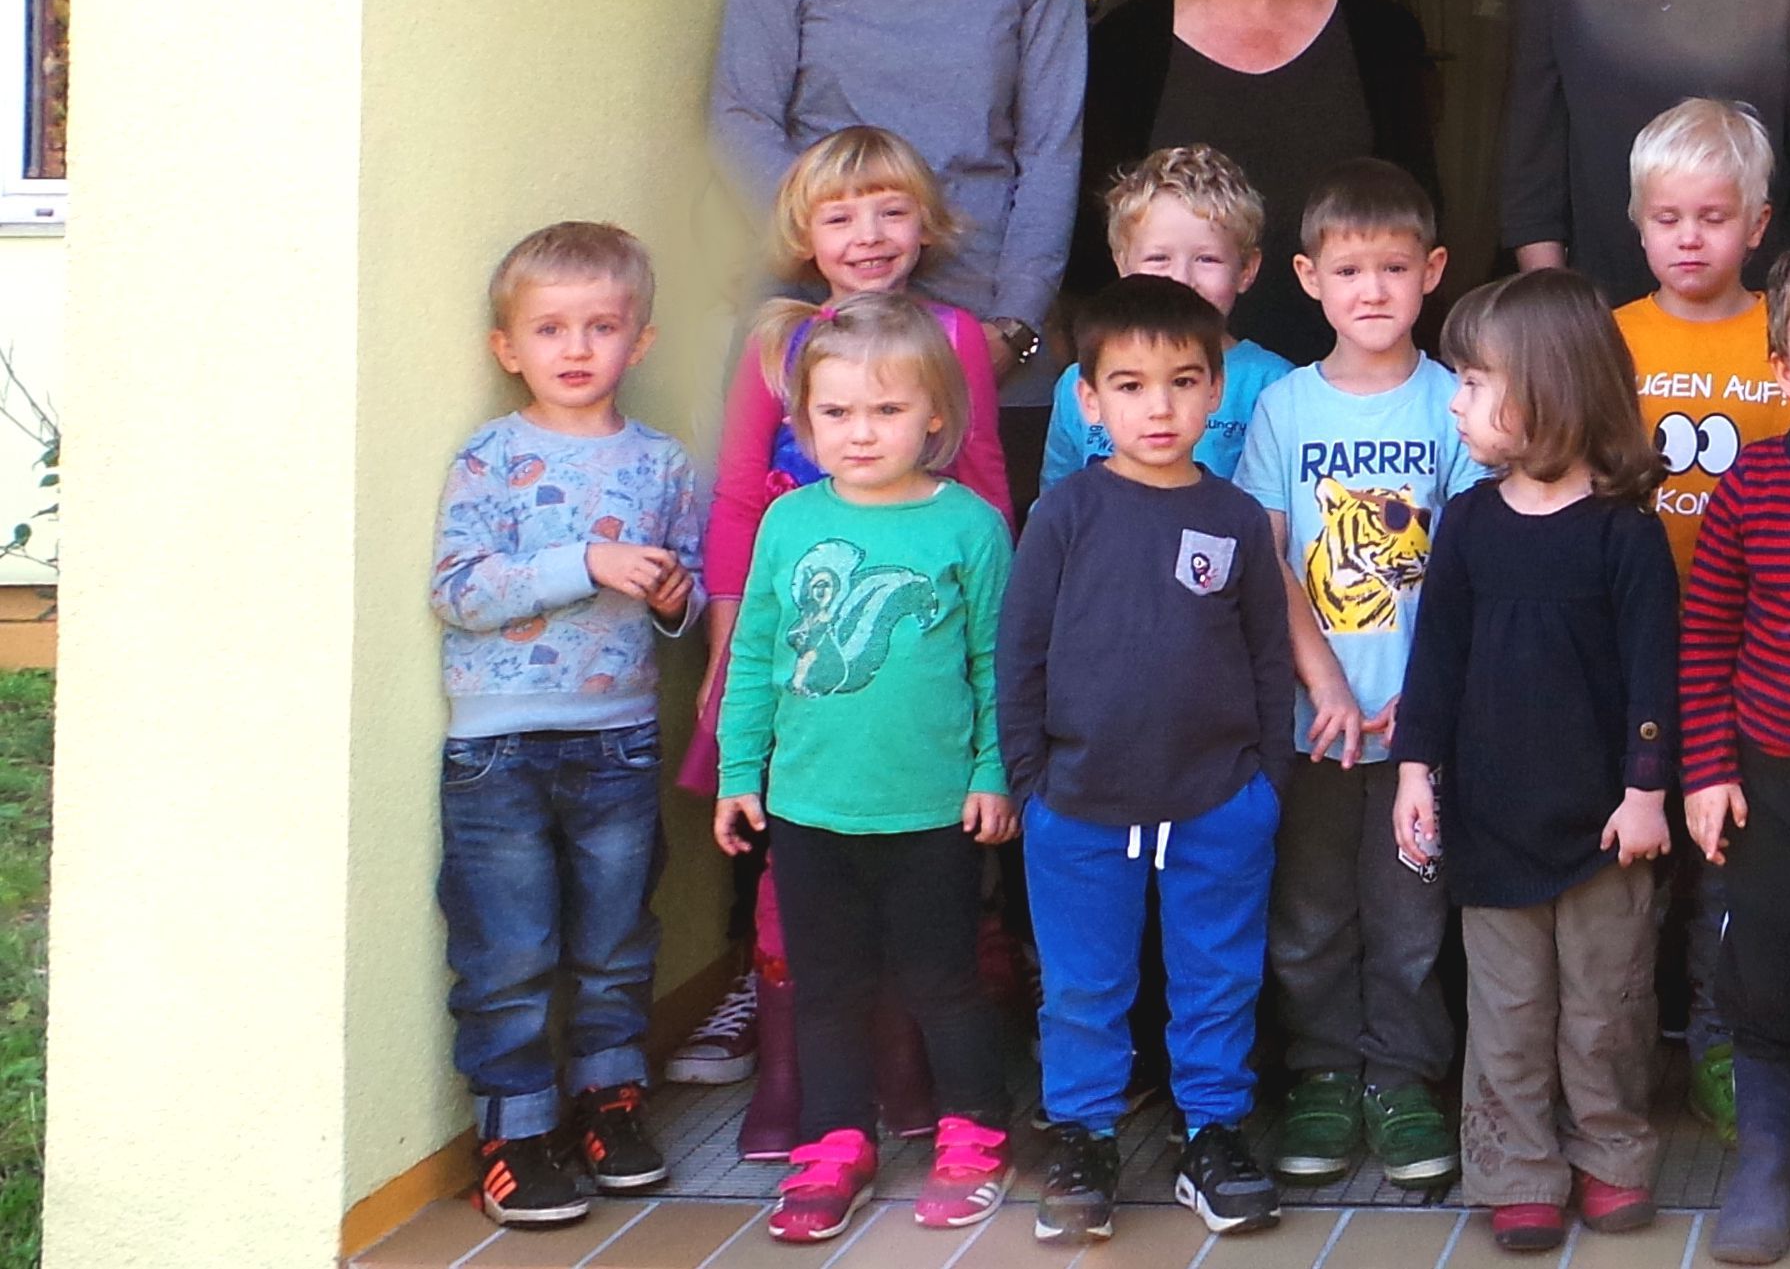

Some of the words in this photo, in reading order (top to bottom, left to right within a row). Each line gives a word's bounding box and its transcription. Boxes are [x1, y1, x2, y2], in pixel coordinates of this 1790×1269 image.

[1636, 372, 1712, 398] UGEN
[1205, 419, 1247, 438] ungry
[1300, 440, 1436, 483] RARRR!
